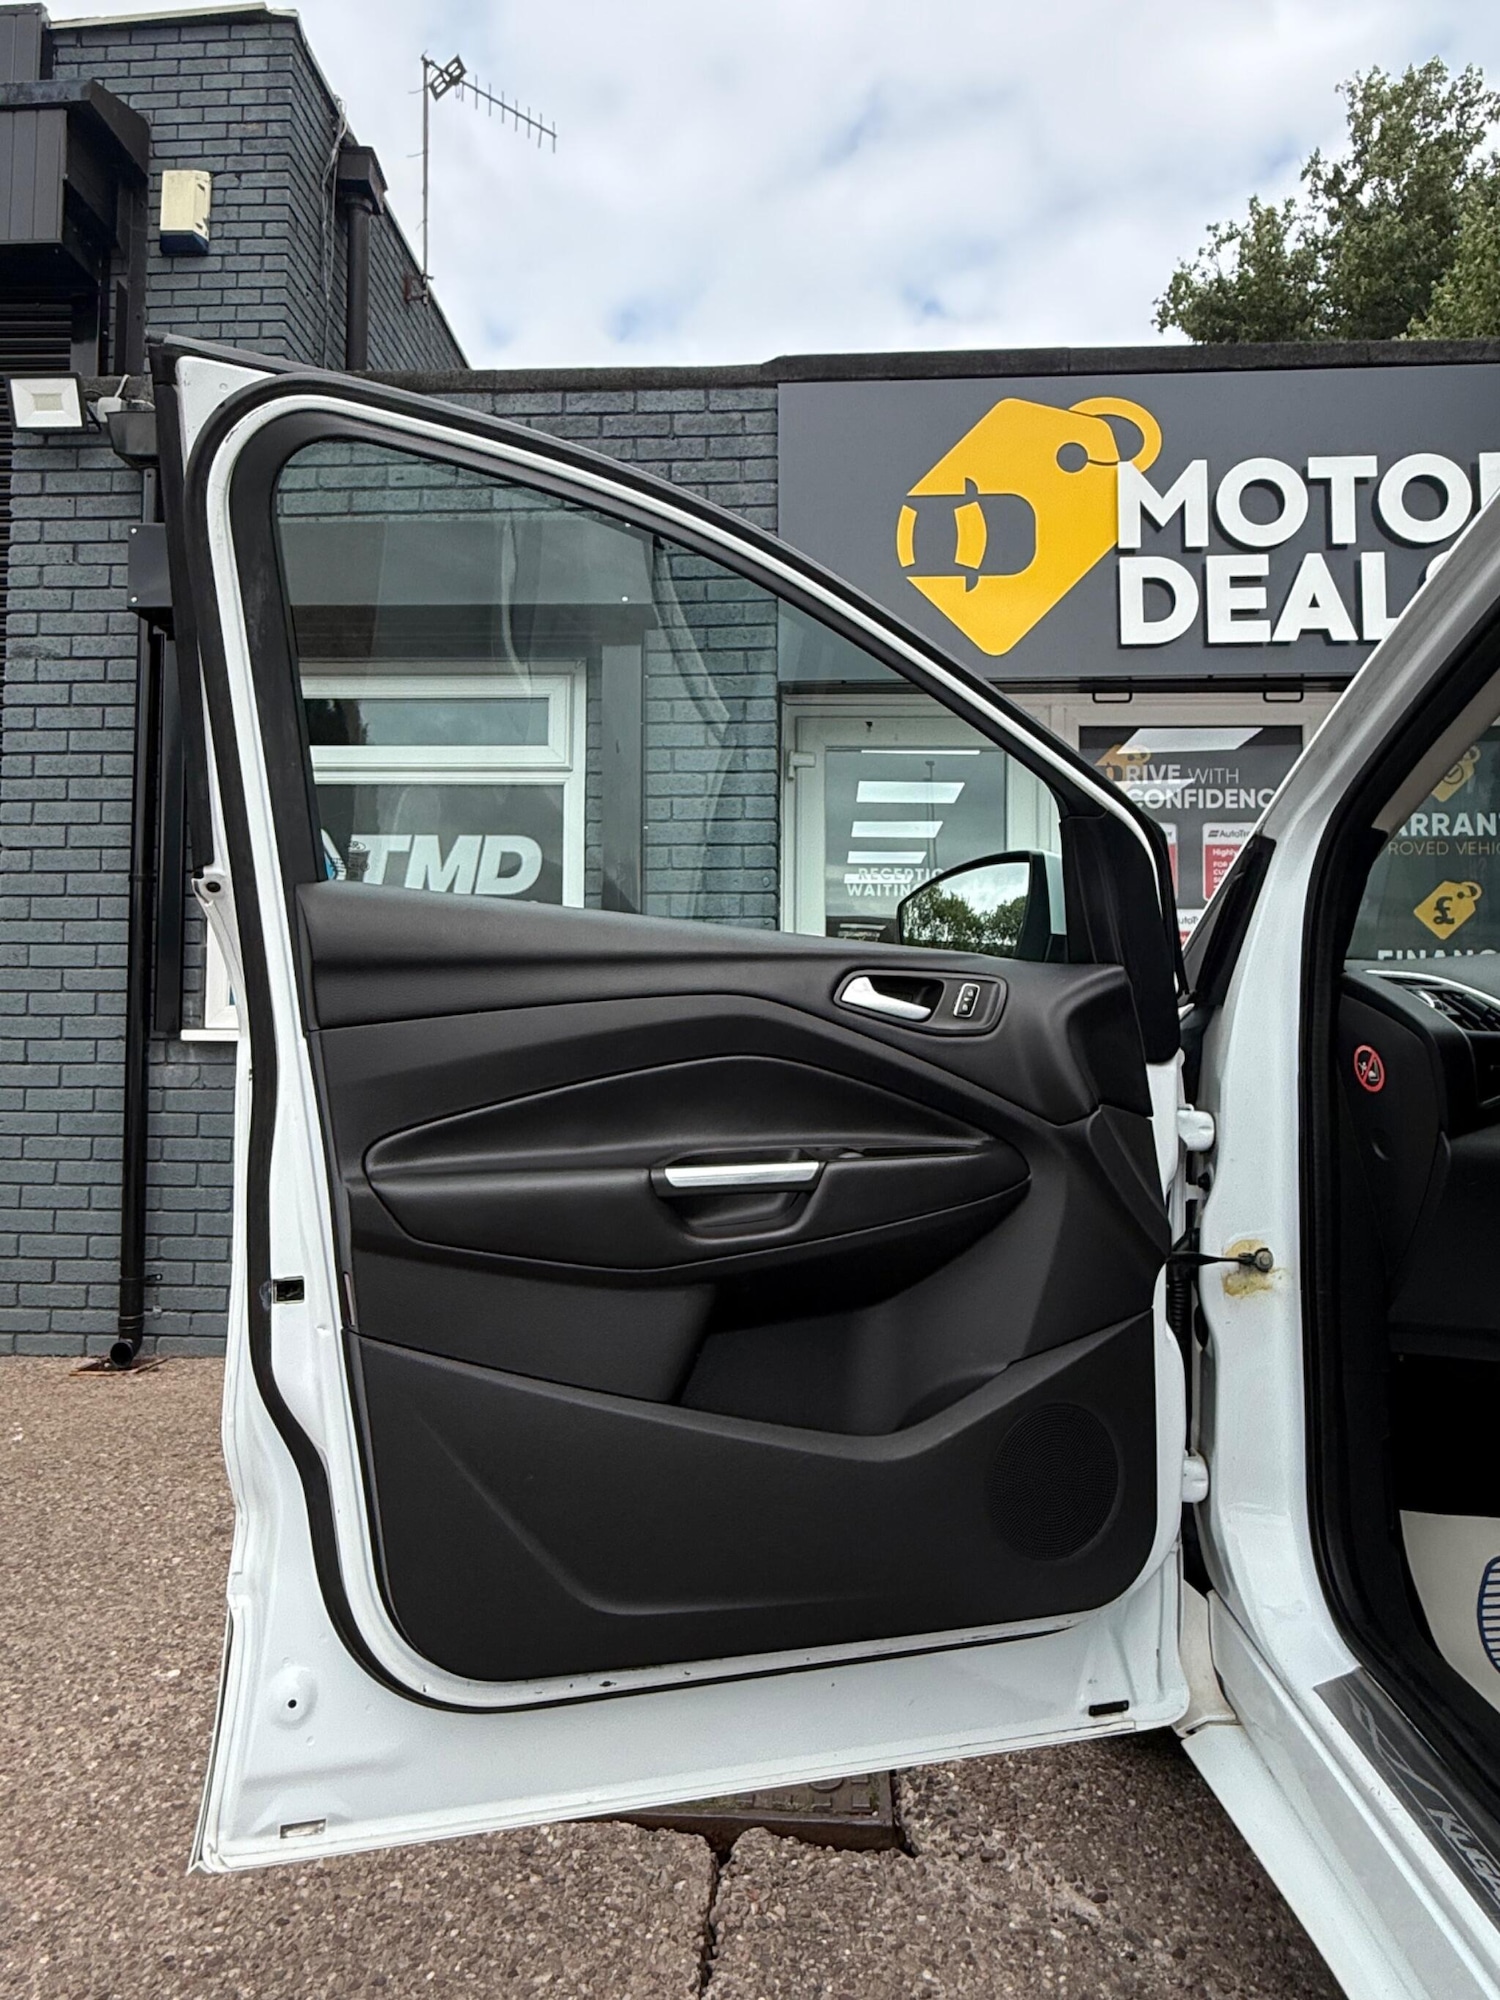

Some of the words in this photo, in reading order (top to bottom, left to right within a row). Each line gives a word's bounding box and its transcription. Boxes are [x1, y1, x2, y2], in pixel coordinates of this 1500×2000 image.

[1118, 550, 1452, 645] DEAL
[1188, 767, 1240, 784] WITH
[1399, 812, 1500, 836] ARRAN
[351, 834, 543, 895] TMD
